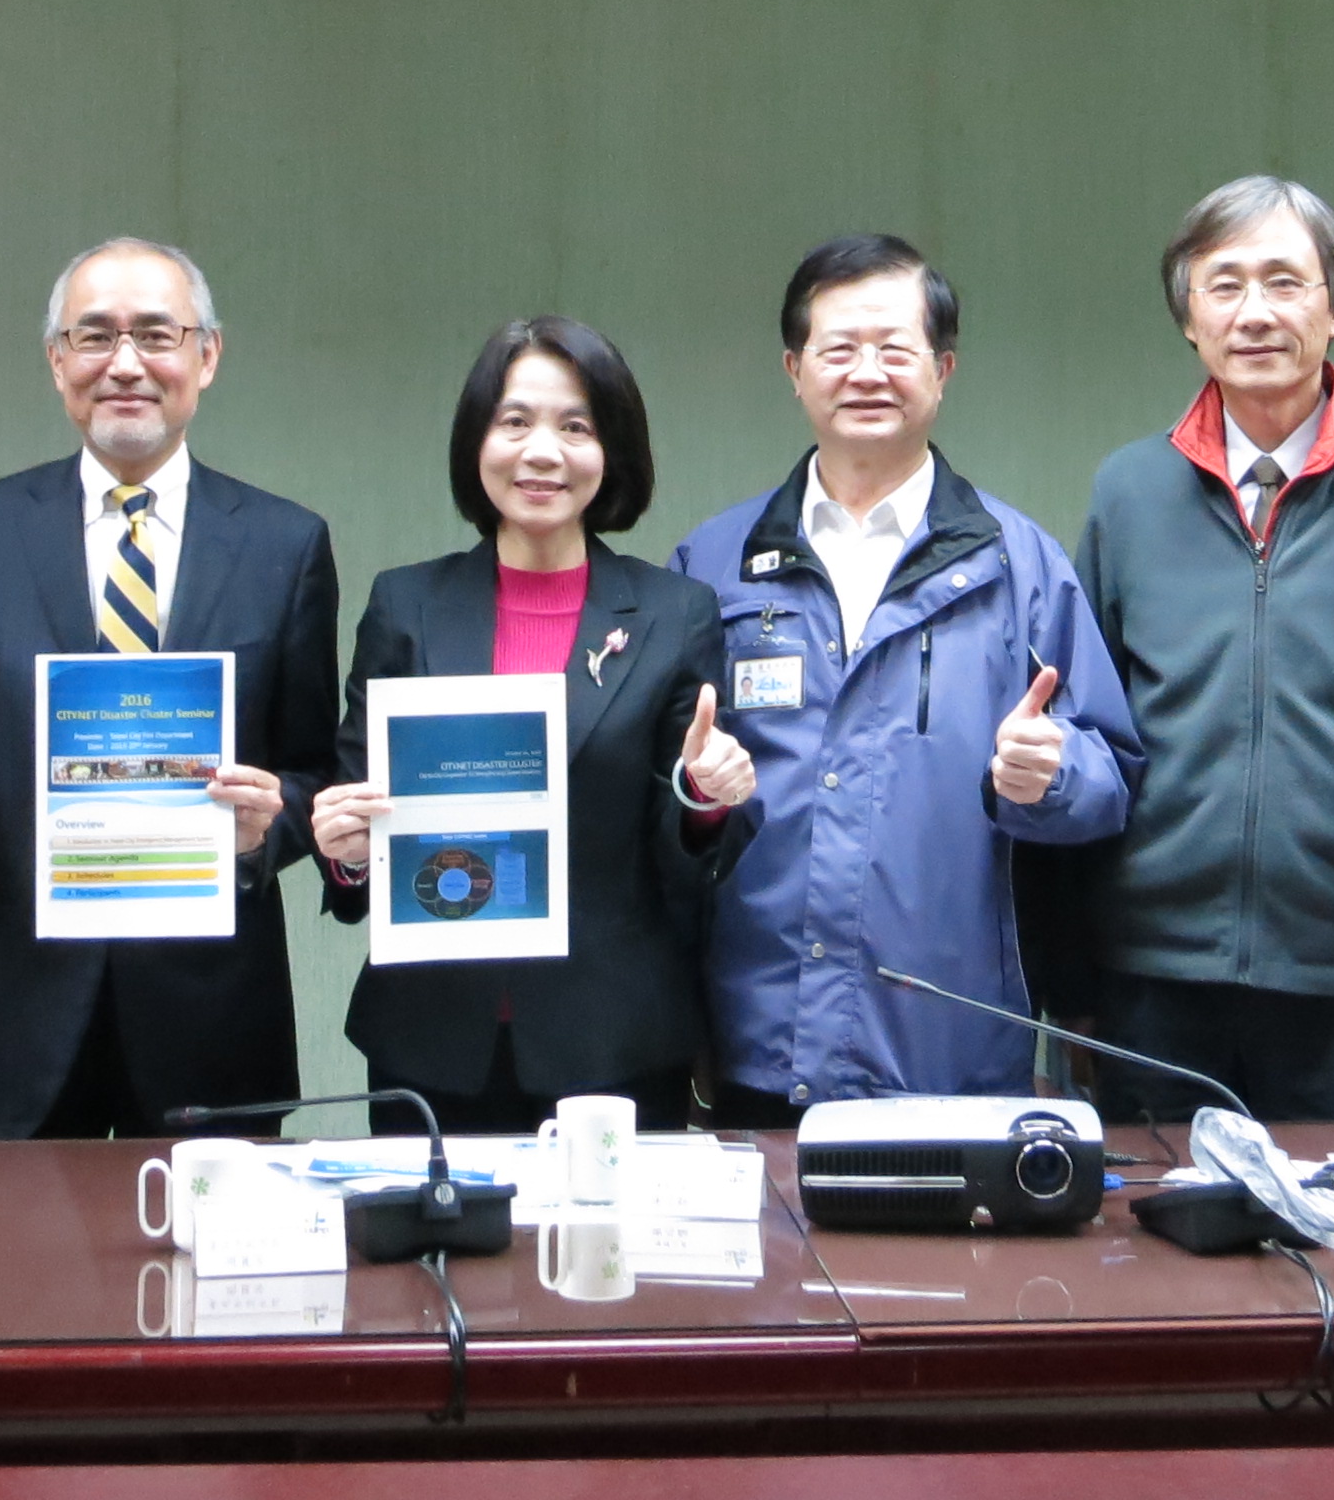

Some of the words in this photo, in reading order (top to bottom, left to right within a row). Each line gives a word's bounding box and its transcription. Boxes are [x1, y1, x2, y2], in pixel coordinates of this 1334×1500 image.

[120, 694, 152, 707] 2016
[100, 709, 137, 720] Disaster
[140, 709, 173, 719] Cluster
[176, 708, 215, 719] Seminar
[472, 760, 508, 770] DISASTER
[55, 819, 106, 829] Overview
[108, 853, 139, 864] Agenda
